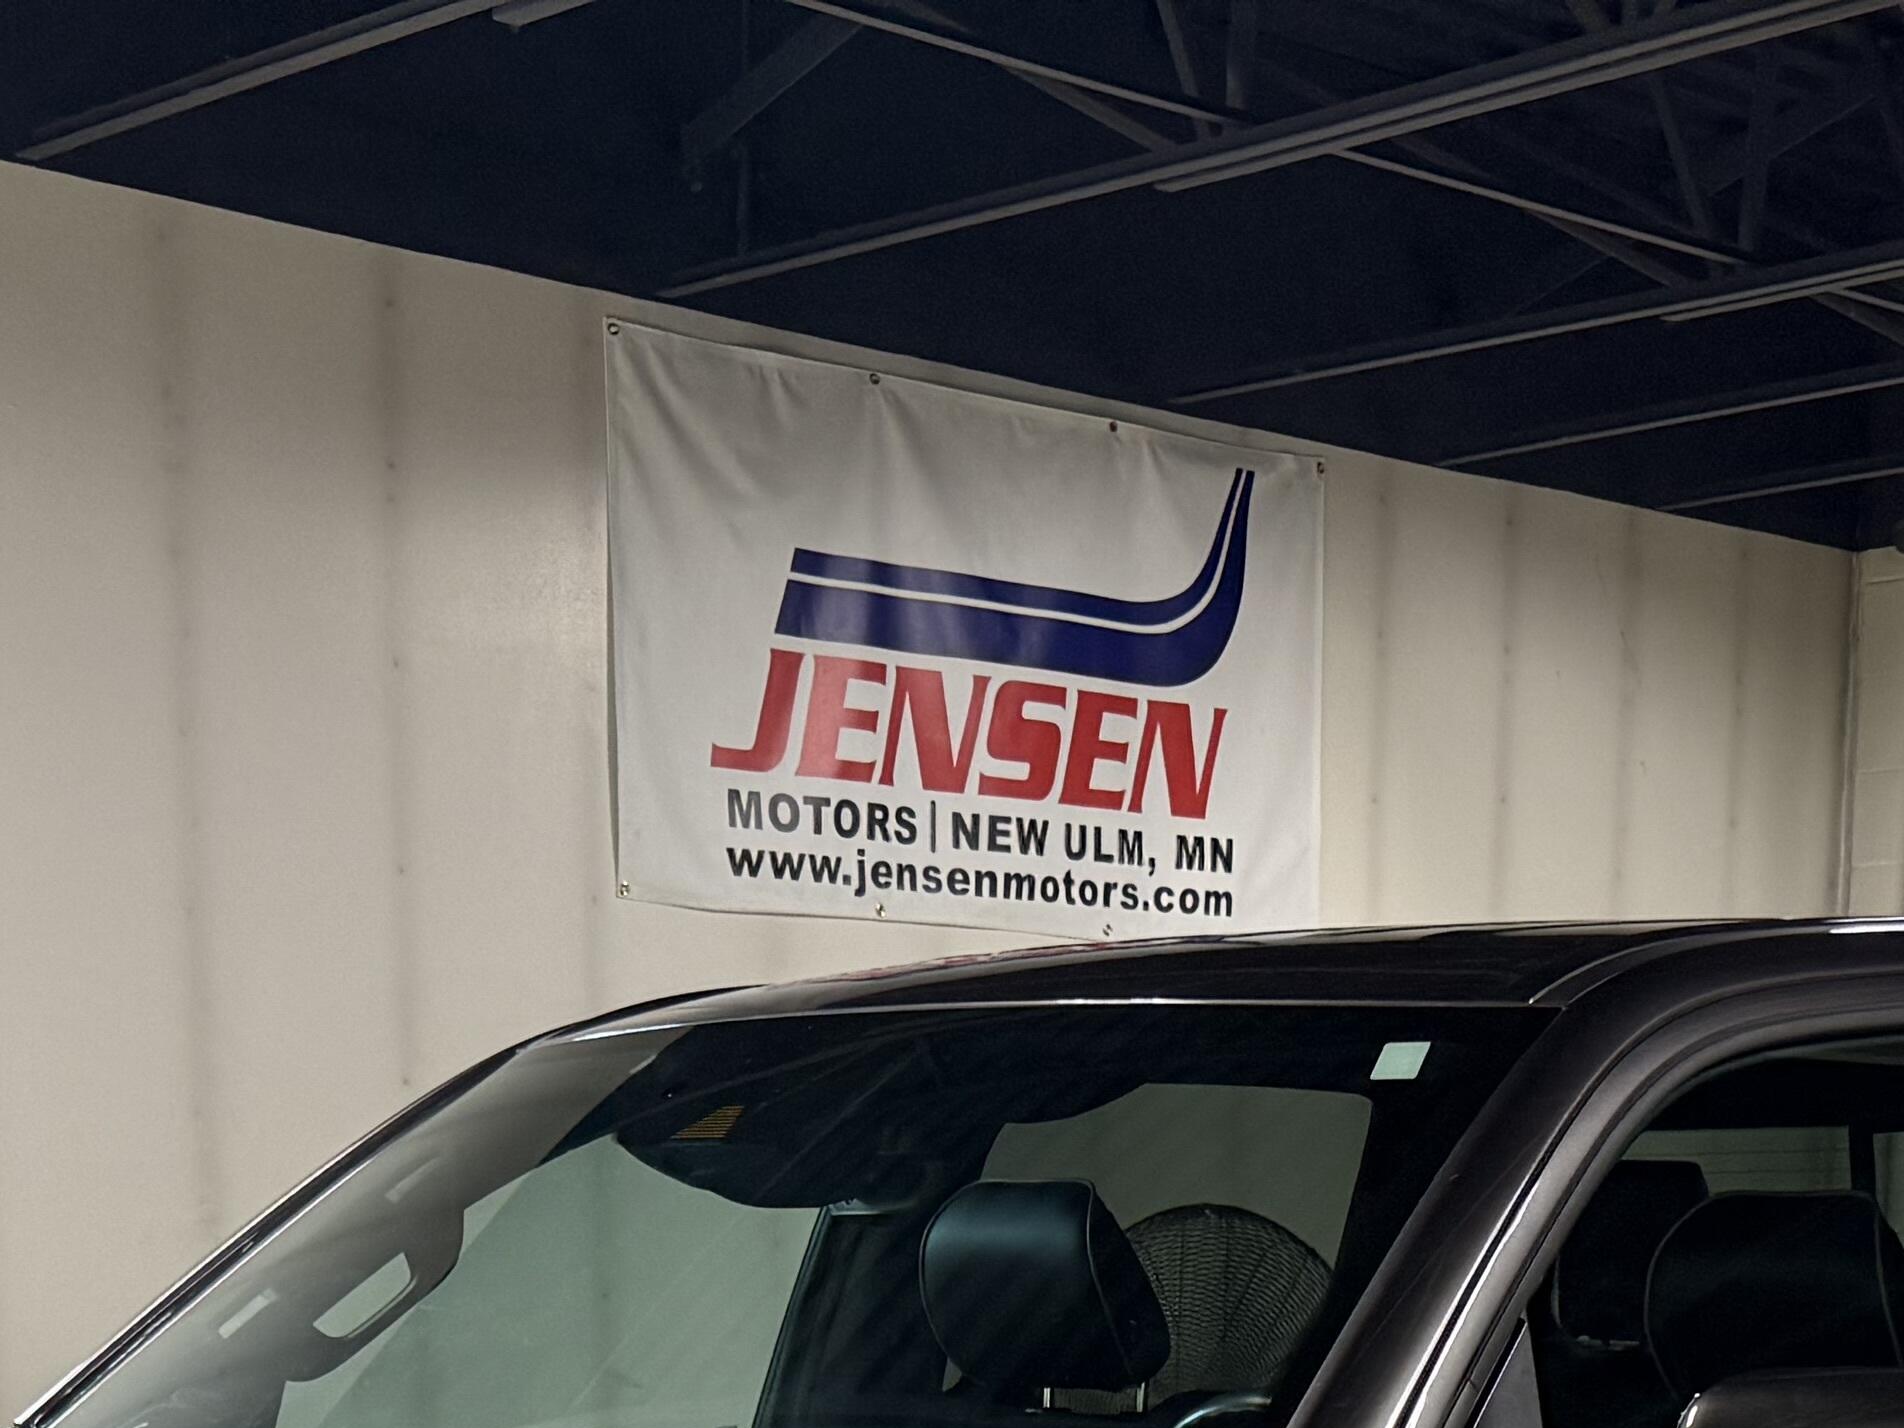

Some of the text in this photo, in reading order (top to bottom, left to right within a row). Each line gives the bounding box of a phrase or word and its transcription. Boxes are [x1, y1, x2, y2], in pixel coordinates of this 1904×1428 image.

[709, 647, 1228, 820] JENSEN
[726, 788, 917, 846] MOTORS
[951, 811, 1050, 857] NEW
[1063, 822, 1156, 876] ULM,
[1175, 834, 1234, 874] MN
[725, 846, 1234, 918] www.jensenmotors.com
